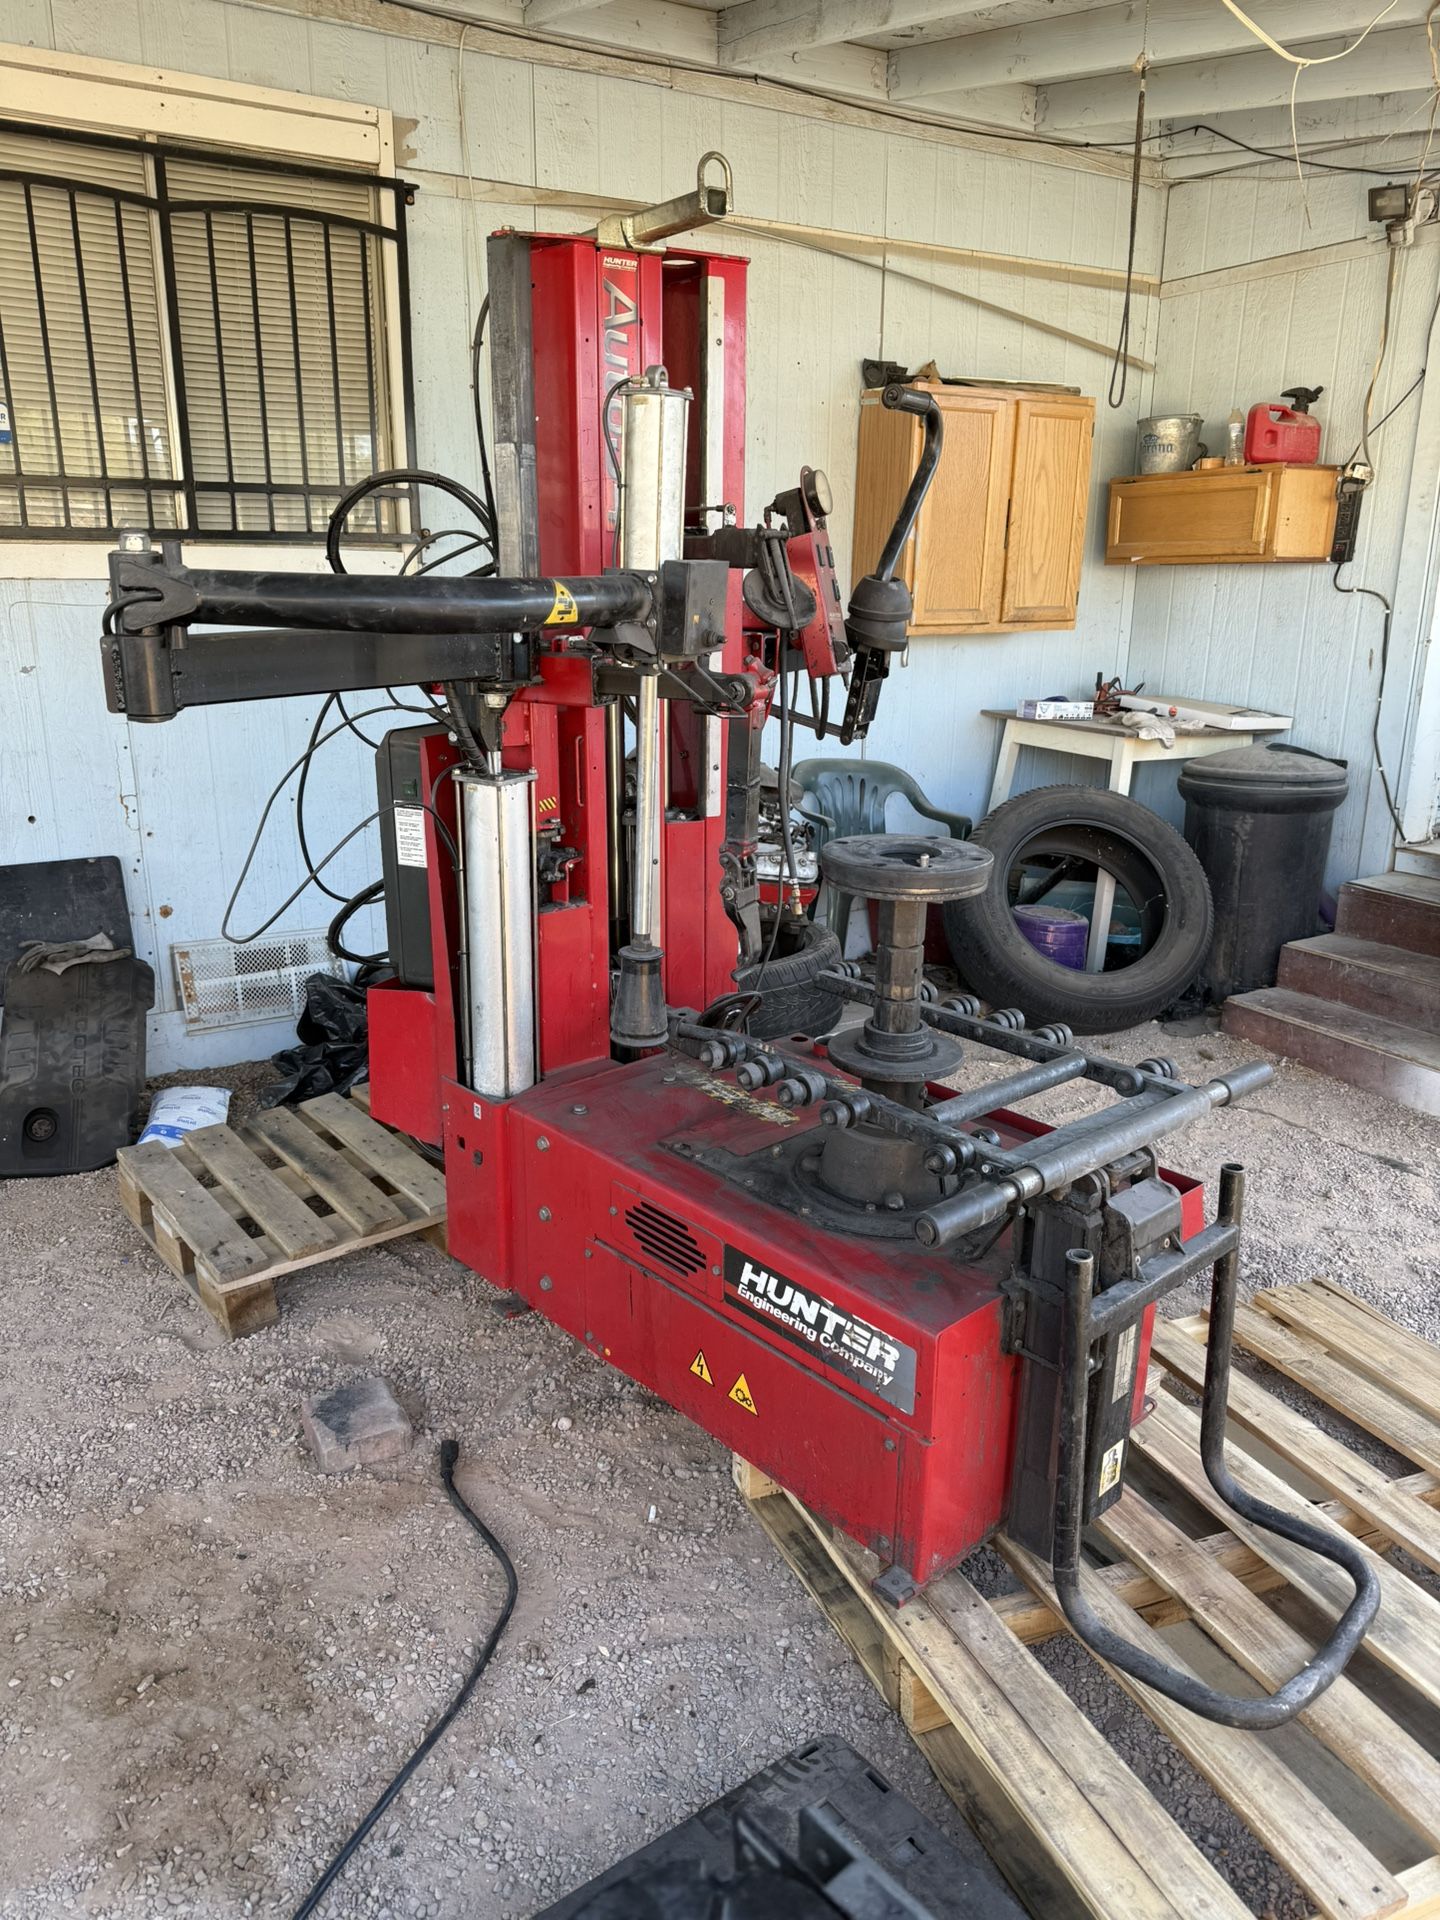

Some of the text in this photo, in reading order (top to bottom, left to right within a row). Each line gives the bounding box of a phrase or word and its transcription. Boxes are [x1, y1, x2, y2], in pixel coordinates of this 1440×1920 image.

[603, 256, 638, 268] HUNTER
[737, 1283, 894, 1386] Engineering Company
[740, 1262, 901, 1372] HUNTER
